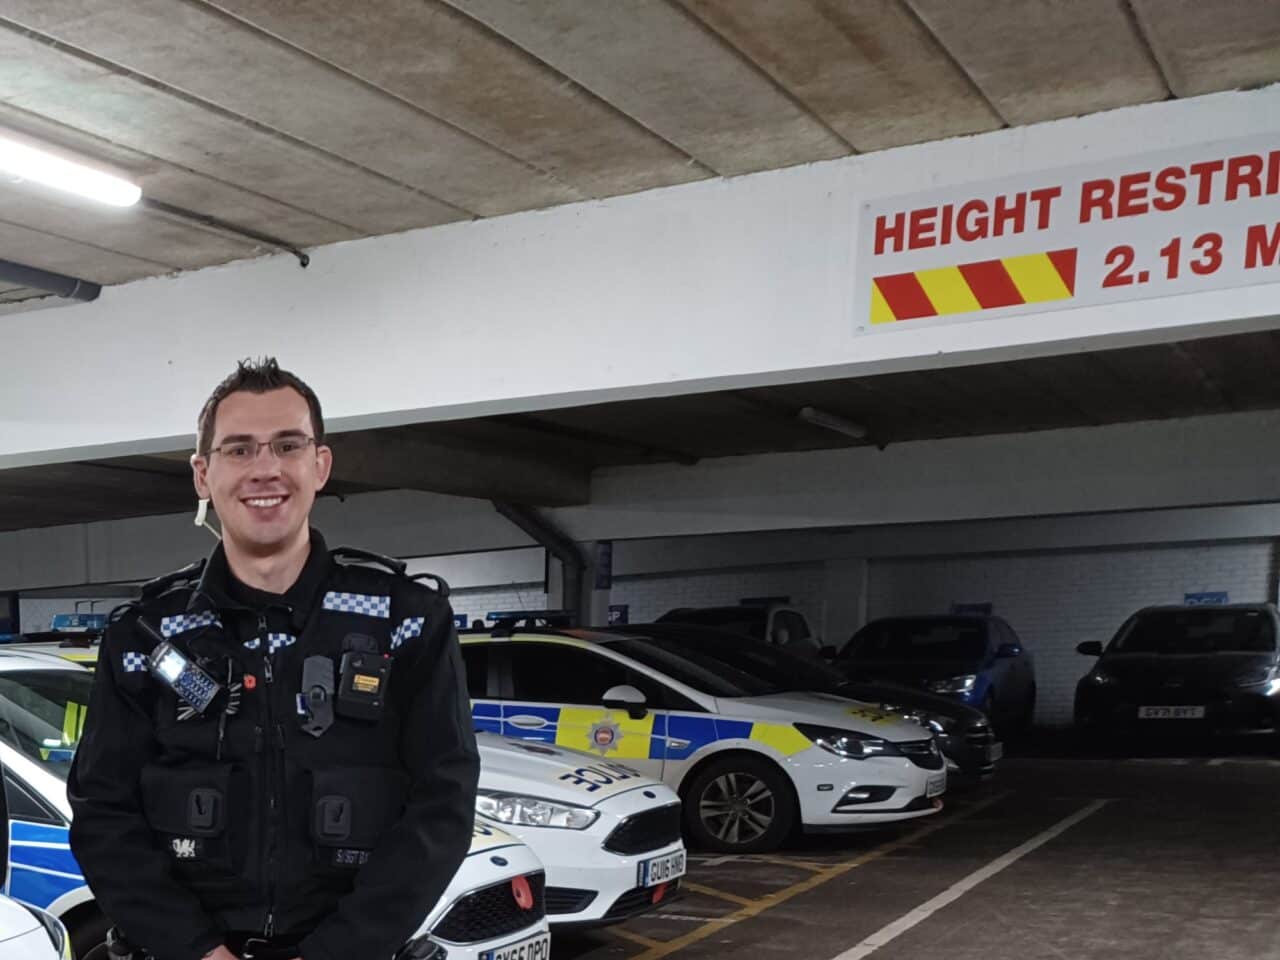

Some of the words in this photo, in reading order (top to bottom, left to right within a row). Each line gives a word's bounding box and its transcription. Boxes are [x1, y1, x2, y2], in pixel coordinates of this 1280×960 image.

[874, 186, 1062, 255] HEIGHT
[1078, 149, 1280, 224] RESTRI
[1101, 232, 1223, 288] 2.13
